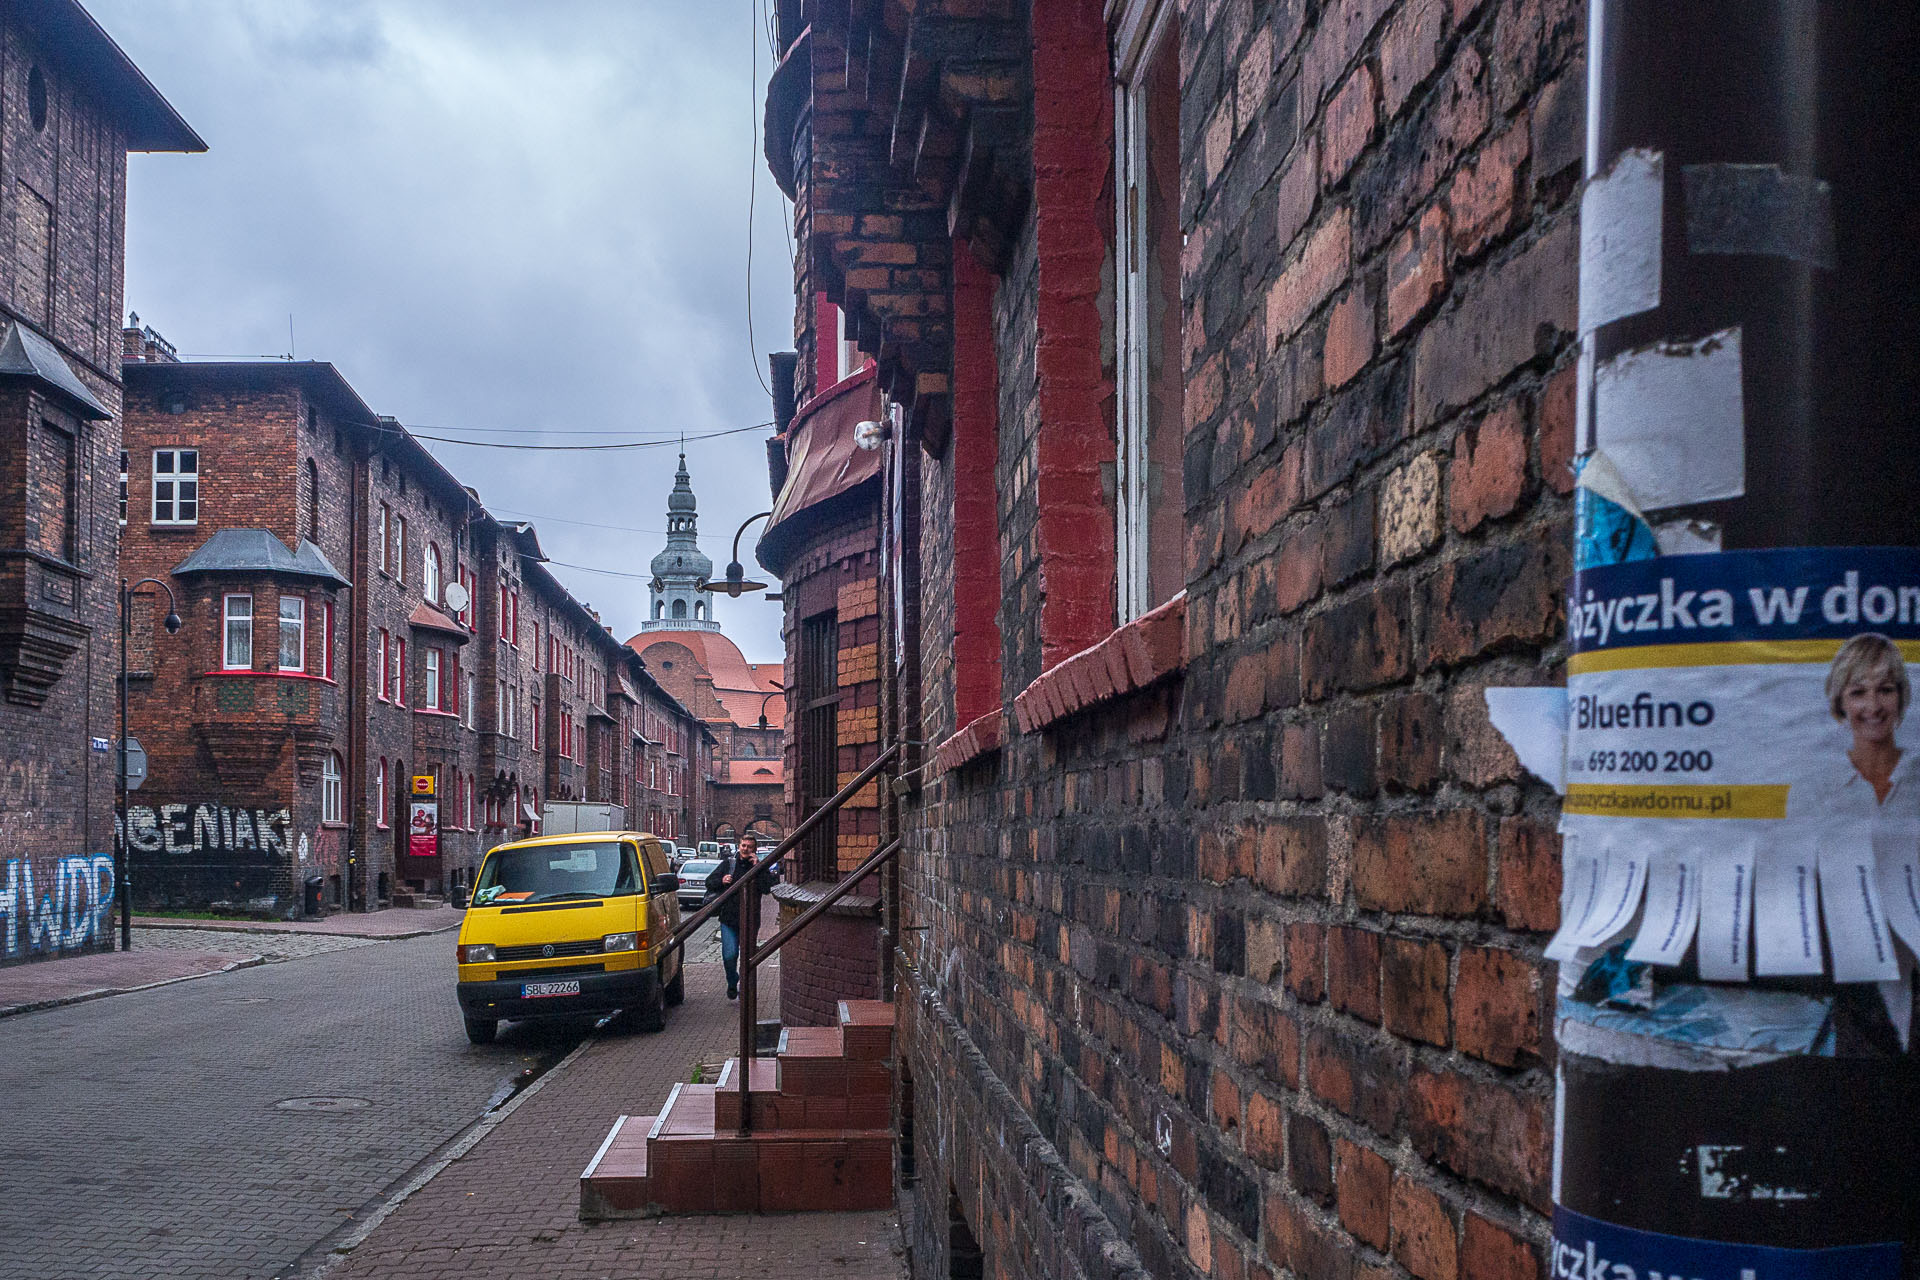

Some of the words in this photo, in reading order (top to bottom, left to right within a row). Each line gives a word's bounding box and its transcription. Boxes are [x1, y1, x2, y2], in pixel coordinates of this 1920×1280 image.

[1748, 586, 1809, 625] w
[1578, 691, 1715, 729] Bluefino
[1588, 750, 1617, 772] 693
[1619, 750, 1658, 772] 200
[1663, 750, 1714, 772] 200
[526, 984, 546, 996] SBL
[548, 981, 579, 994] 22266
